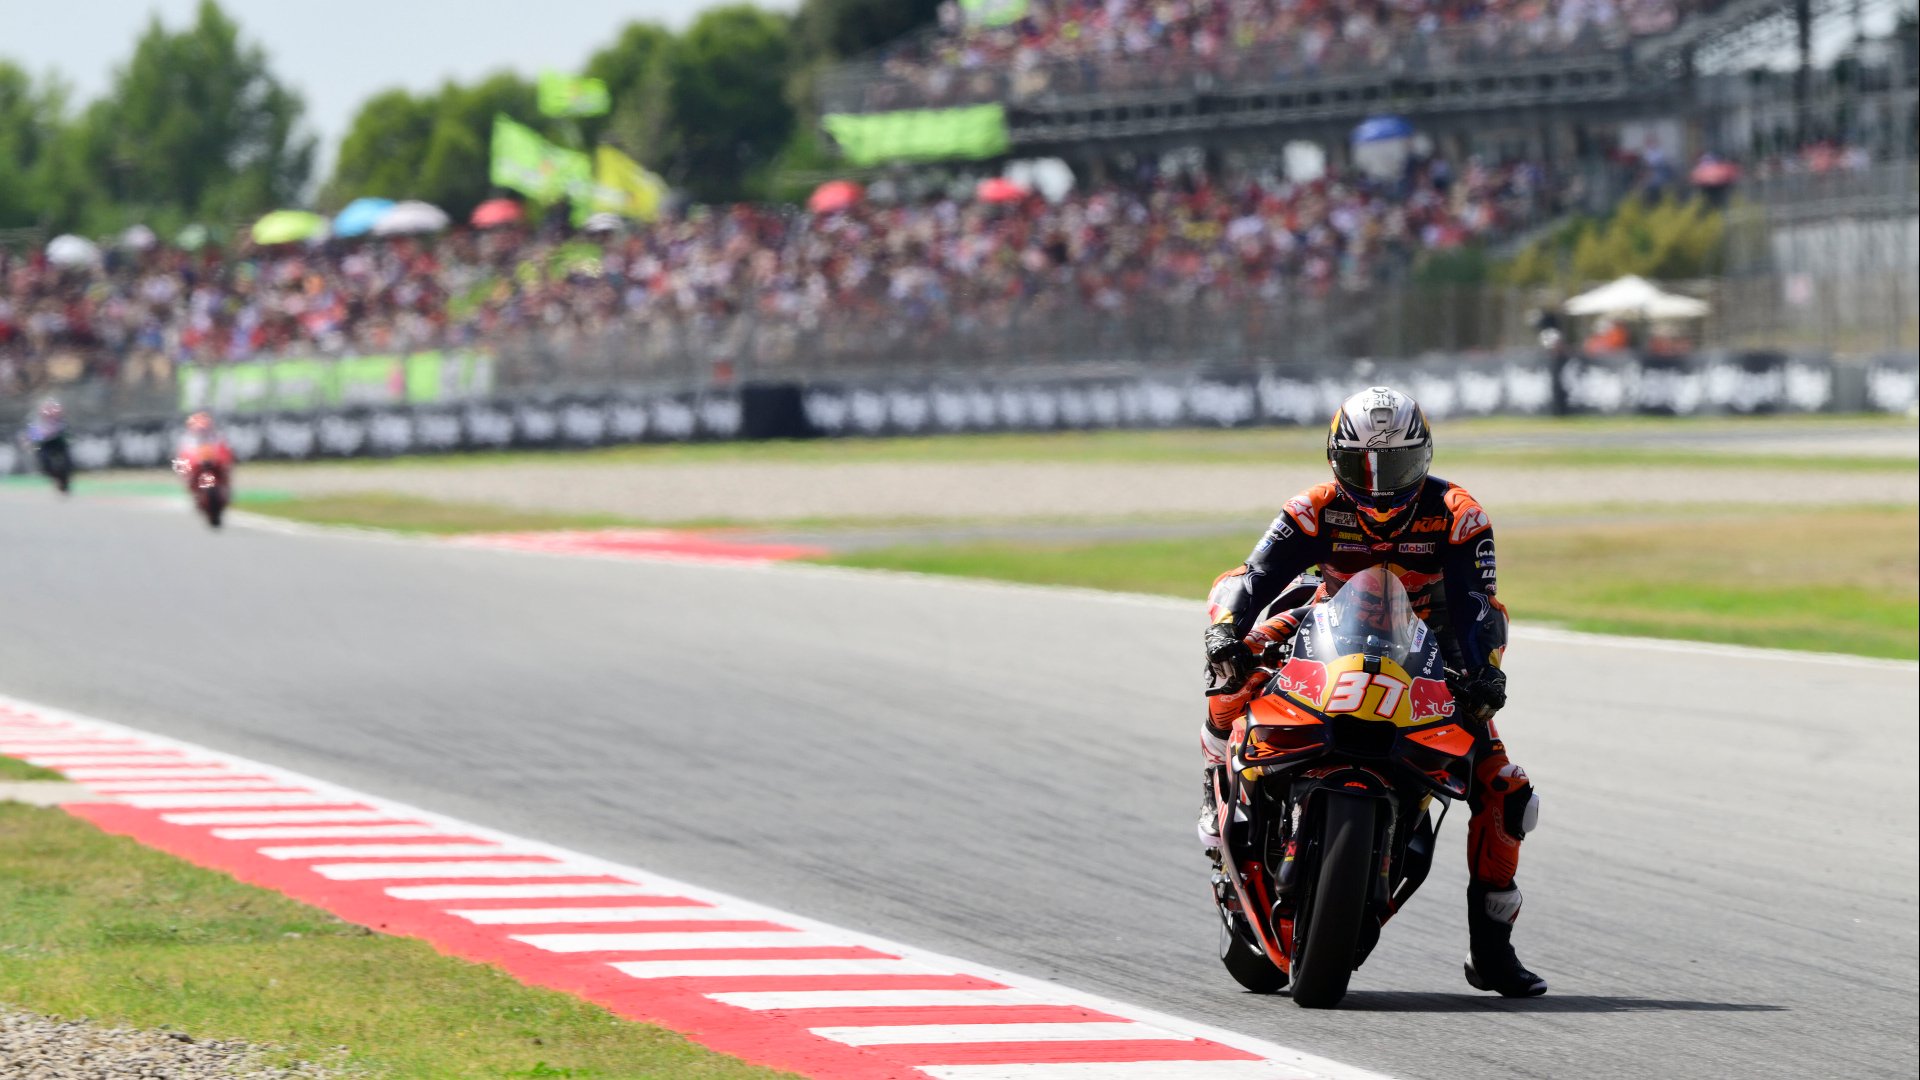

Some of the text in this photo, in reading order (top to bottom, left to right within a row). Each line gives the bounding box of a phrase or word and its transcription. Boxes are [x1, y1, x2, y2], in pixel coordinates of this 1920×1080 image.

[1411, 516, 1447, 532] KTM
[1400, 543, 1426, 552] Mobil
[1303, 636, 1314, 657] BAJAJ
[1426, 646, 1438, 667] BAJAJ
[1324, 670, 1409, 719] 37
